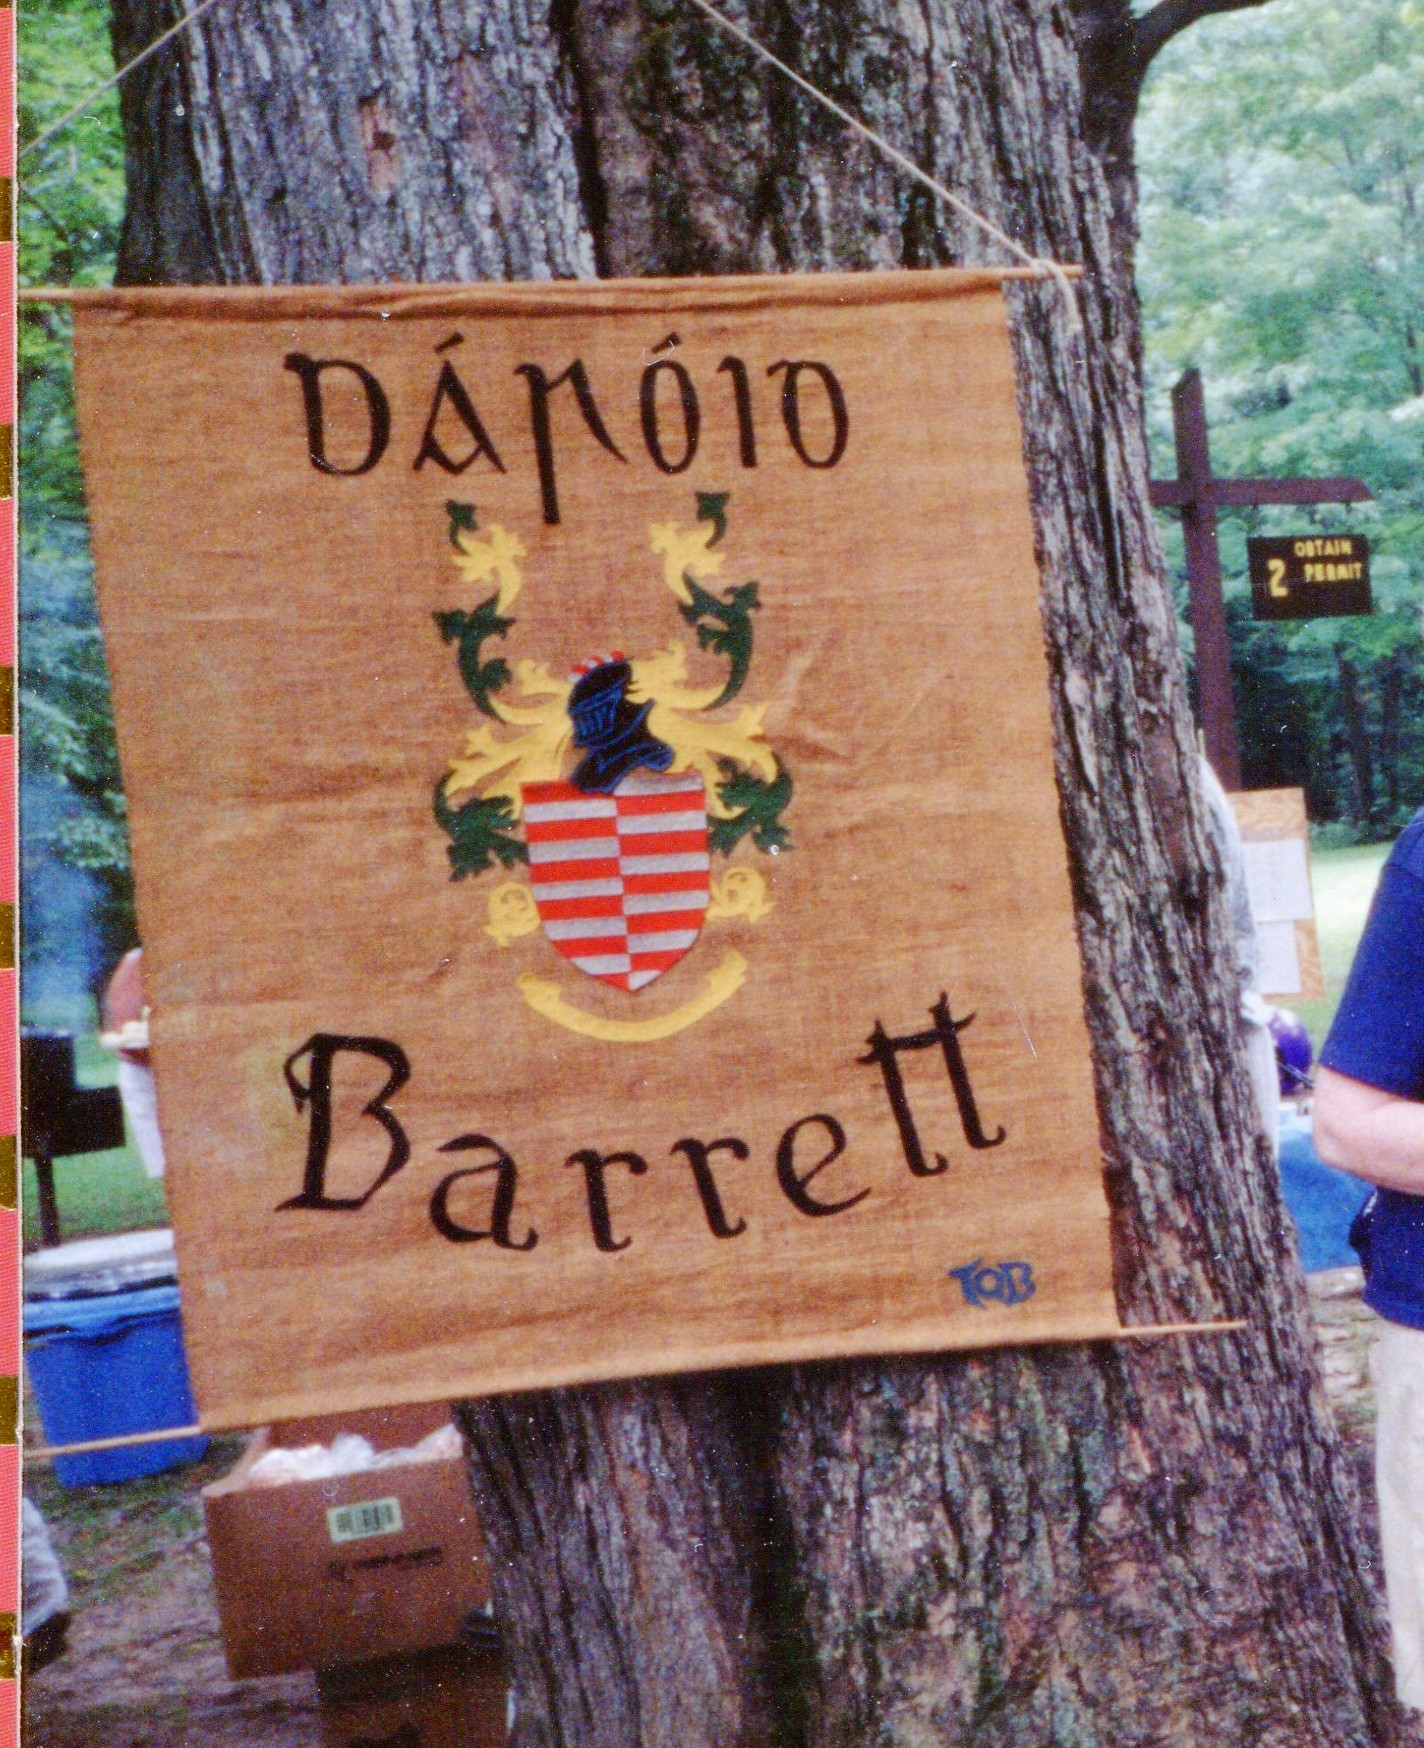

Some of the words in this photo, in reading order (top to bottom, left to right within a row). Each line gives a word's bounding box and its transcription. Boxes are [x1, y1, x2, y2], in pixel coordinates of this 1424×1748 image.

[1293, 538, 1353, 558] OBTAIN
[1266, 557, 1289, 597] 2
[1303, 562, 1363, 582] PERMIT
[274, 991, 1007, 1253] Barrett
